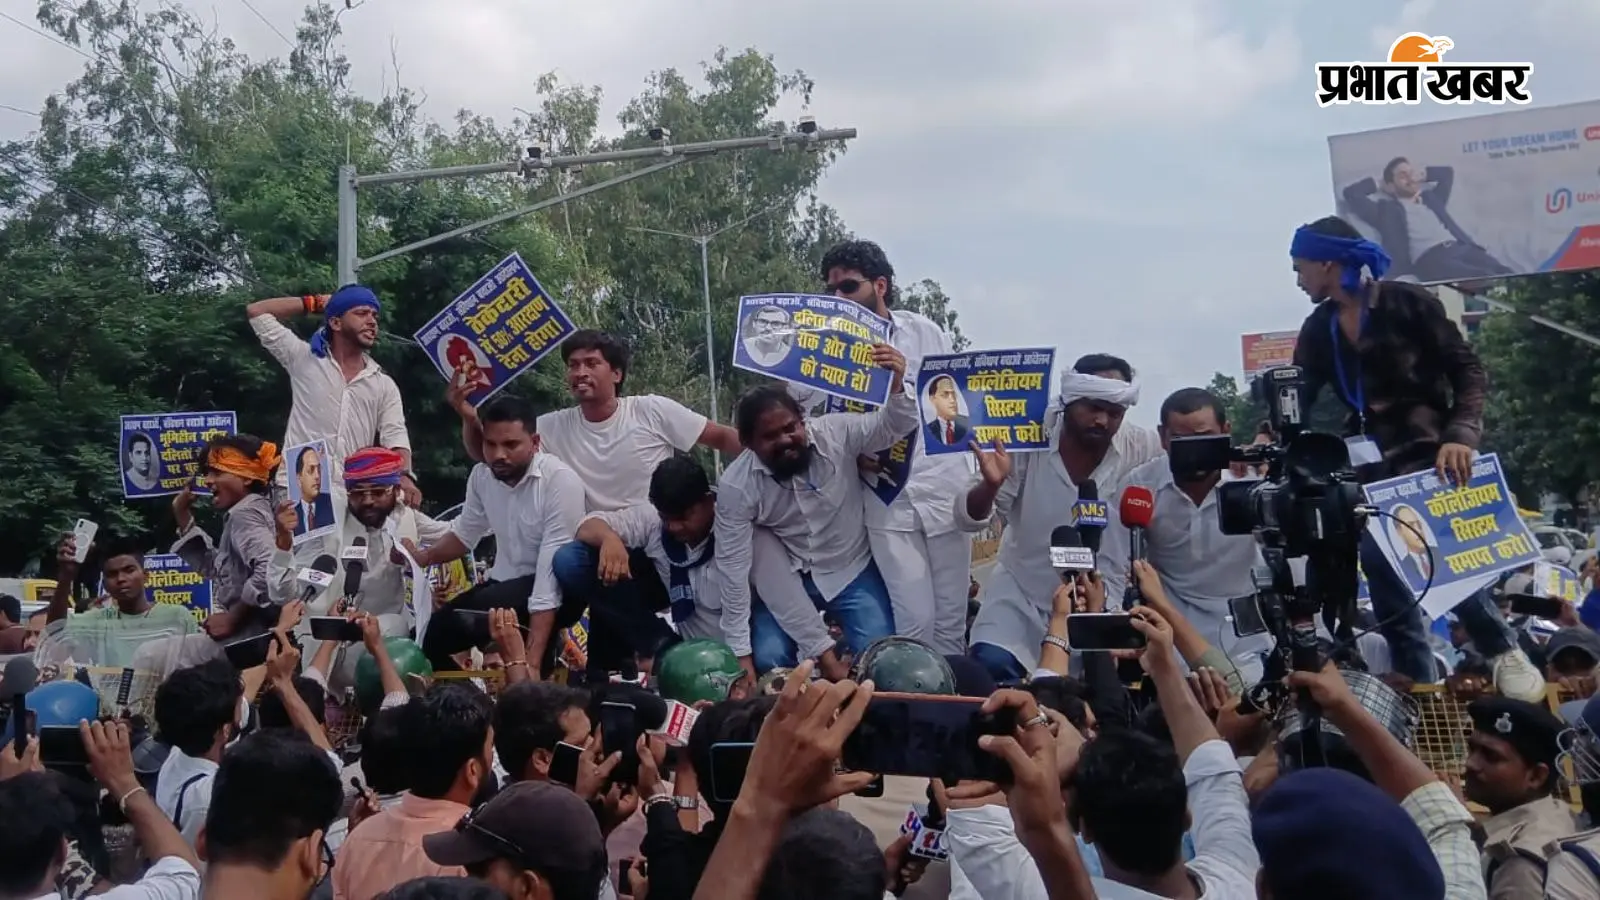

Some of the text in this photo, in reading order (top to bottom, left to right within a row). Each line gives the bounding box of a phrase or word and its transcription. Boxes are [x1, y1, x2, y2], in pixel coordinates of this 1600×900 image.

[462, 277, 532, 335] ठेकेदारी
[477, 333, 499, 354] में
[505, 295, 551, 335] आरक्षण
[792, 309, 827, 329] दलित
[496, 344, 531, 369] देना
[822, 335, 848, 360] और
[800, 355, 818, 378] को
[820, 363, 849, 387] न्याय
[967, 369, 1044, 392] कॉलेजियम
[984, 394, 1027, 418] सिस्टम
[160, 429, 197, 448] भूमिहीन
[972, 425, 1012, 444] समाप्त
[1127, 498, 1152, 509] NDTV
[1424, 482, 1503, 518] कॉलेजियम
[1450, 513, 1501, 543] सिस्टम
[1444, 546, 1497, 575] समाप्त
[153, 589, 193, 605] सिस्टम
